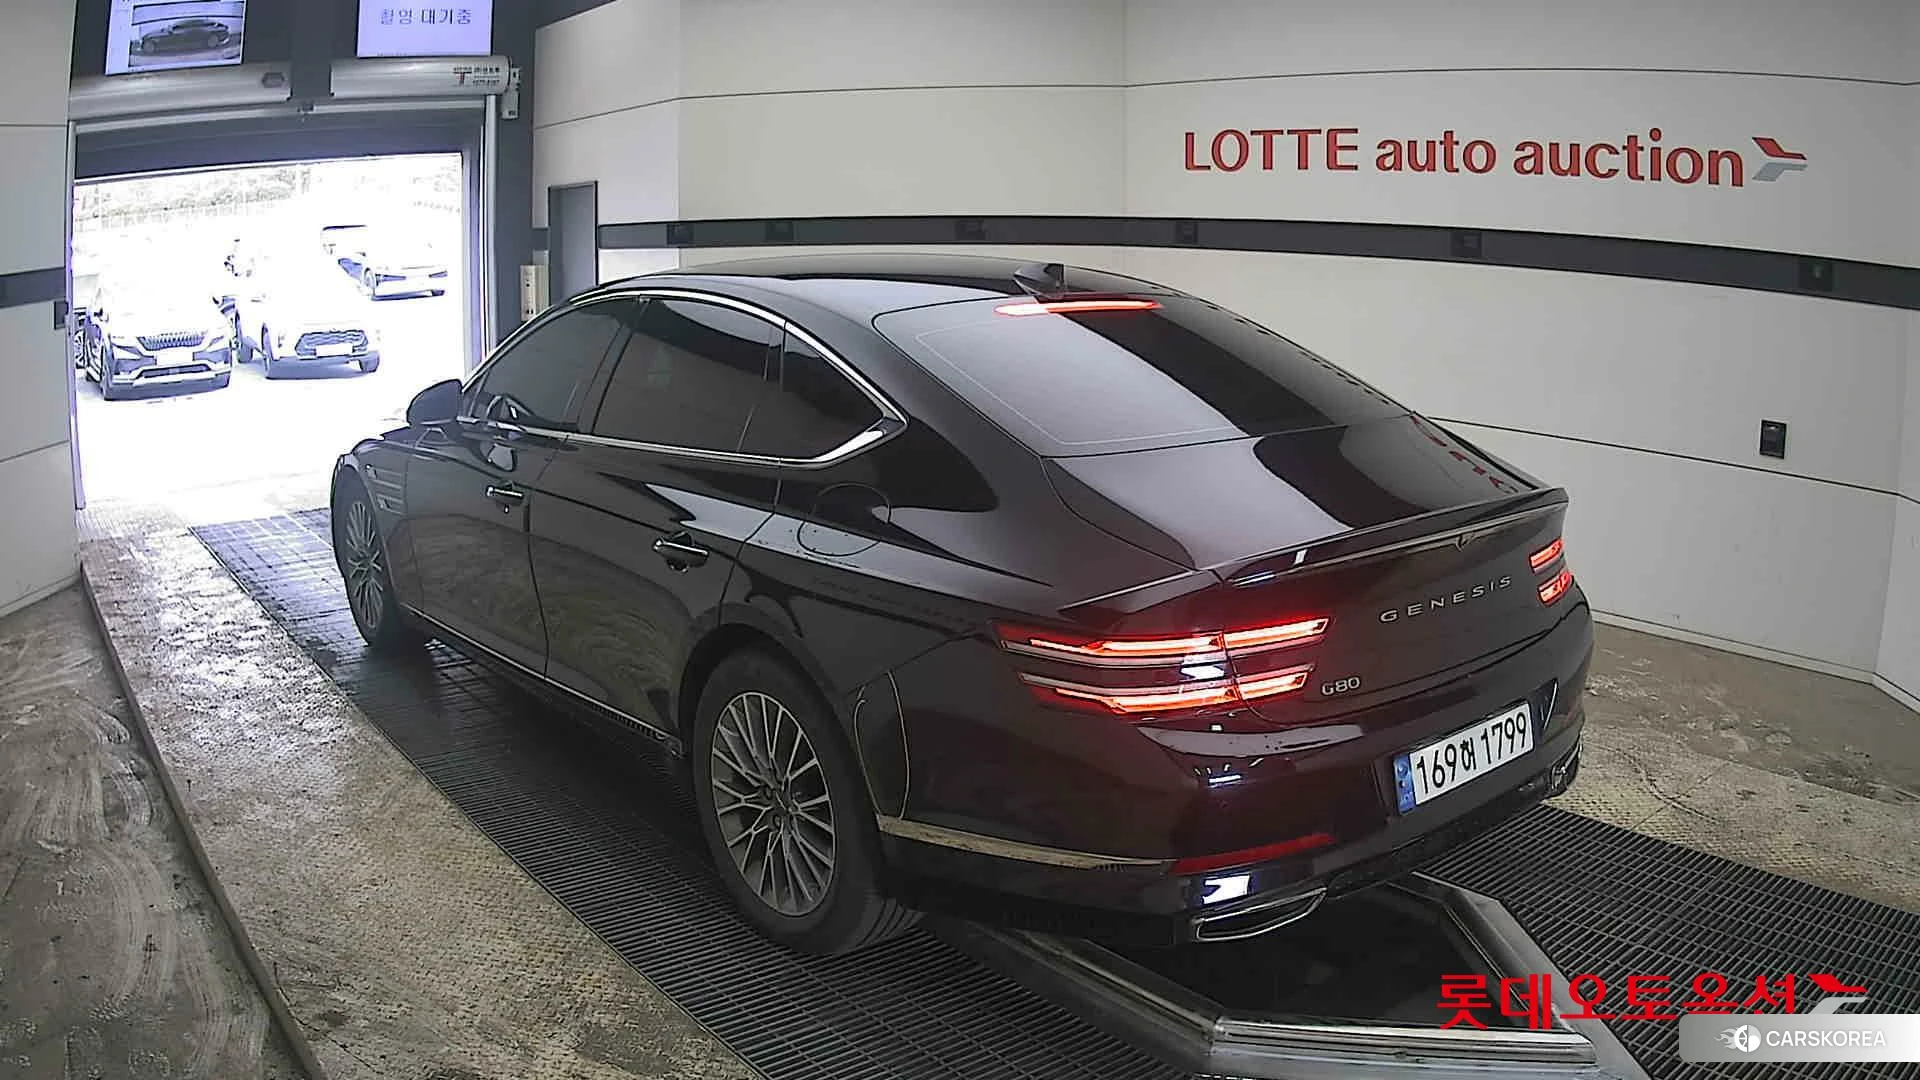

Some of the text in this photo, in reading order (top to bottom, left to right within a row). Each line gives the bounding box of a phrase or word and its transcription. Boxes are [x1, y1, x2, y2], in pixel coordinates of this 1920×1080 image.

[421, 8, 472, 25] 대기중
[1184, 127, 1744, 187] LOTTE auto auction
[1380, 576, 1512, 623] GENESIS
[1321, 676, 1361, 697] G80
[1416, 711, 1527, 795] 169허 1799
